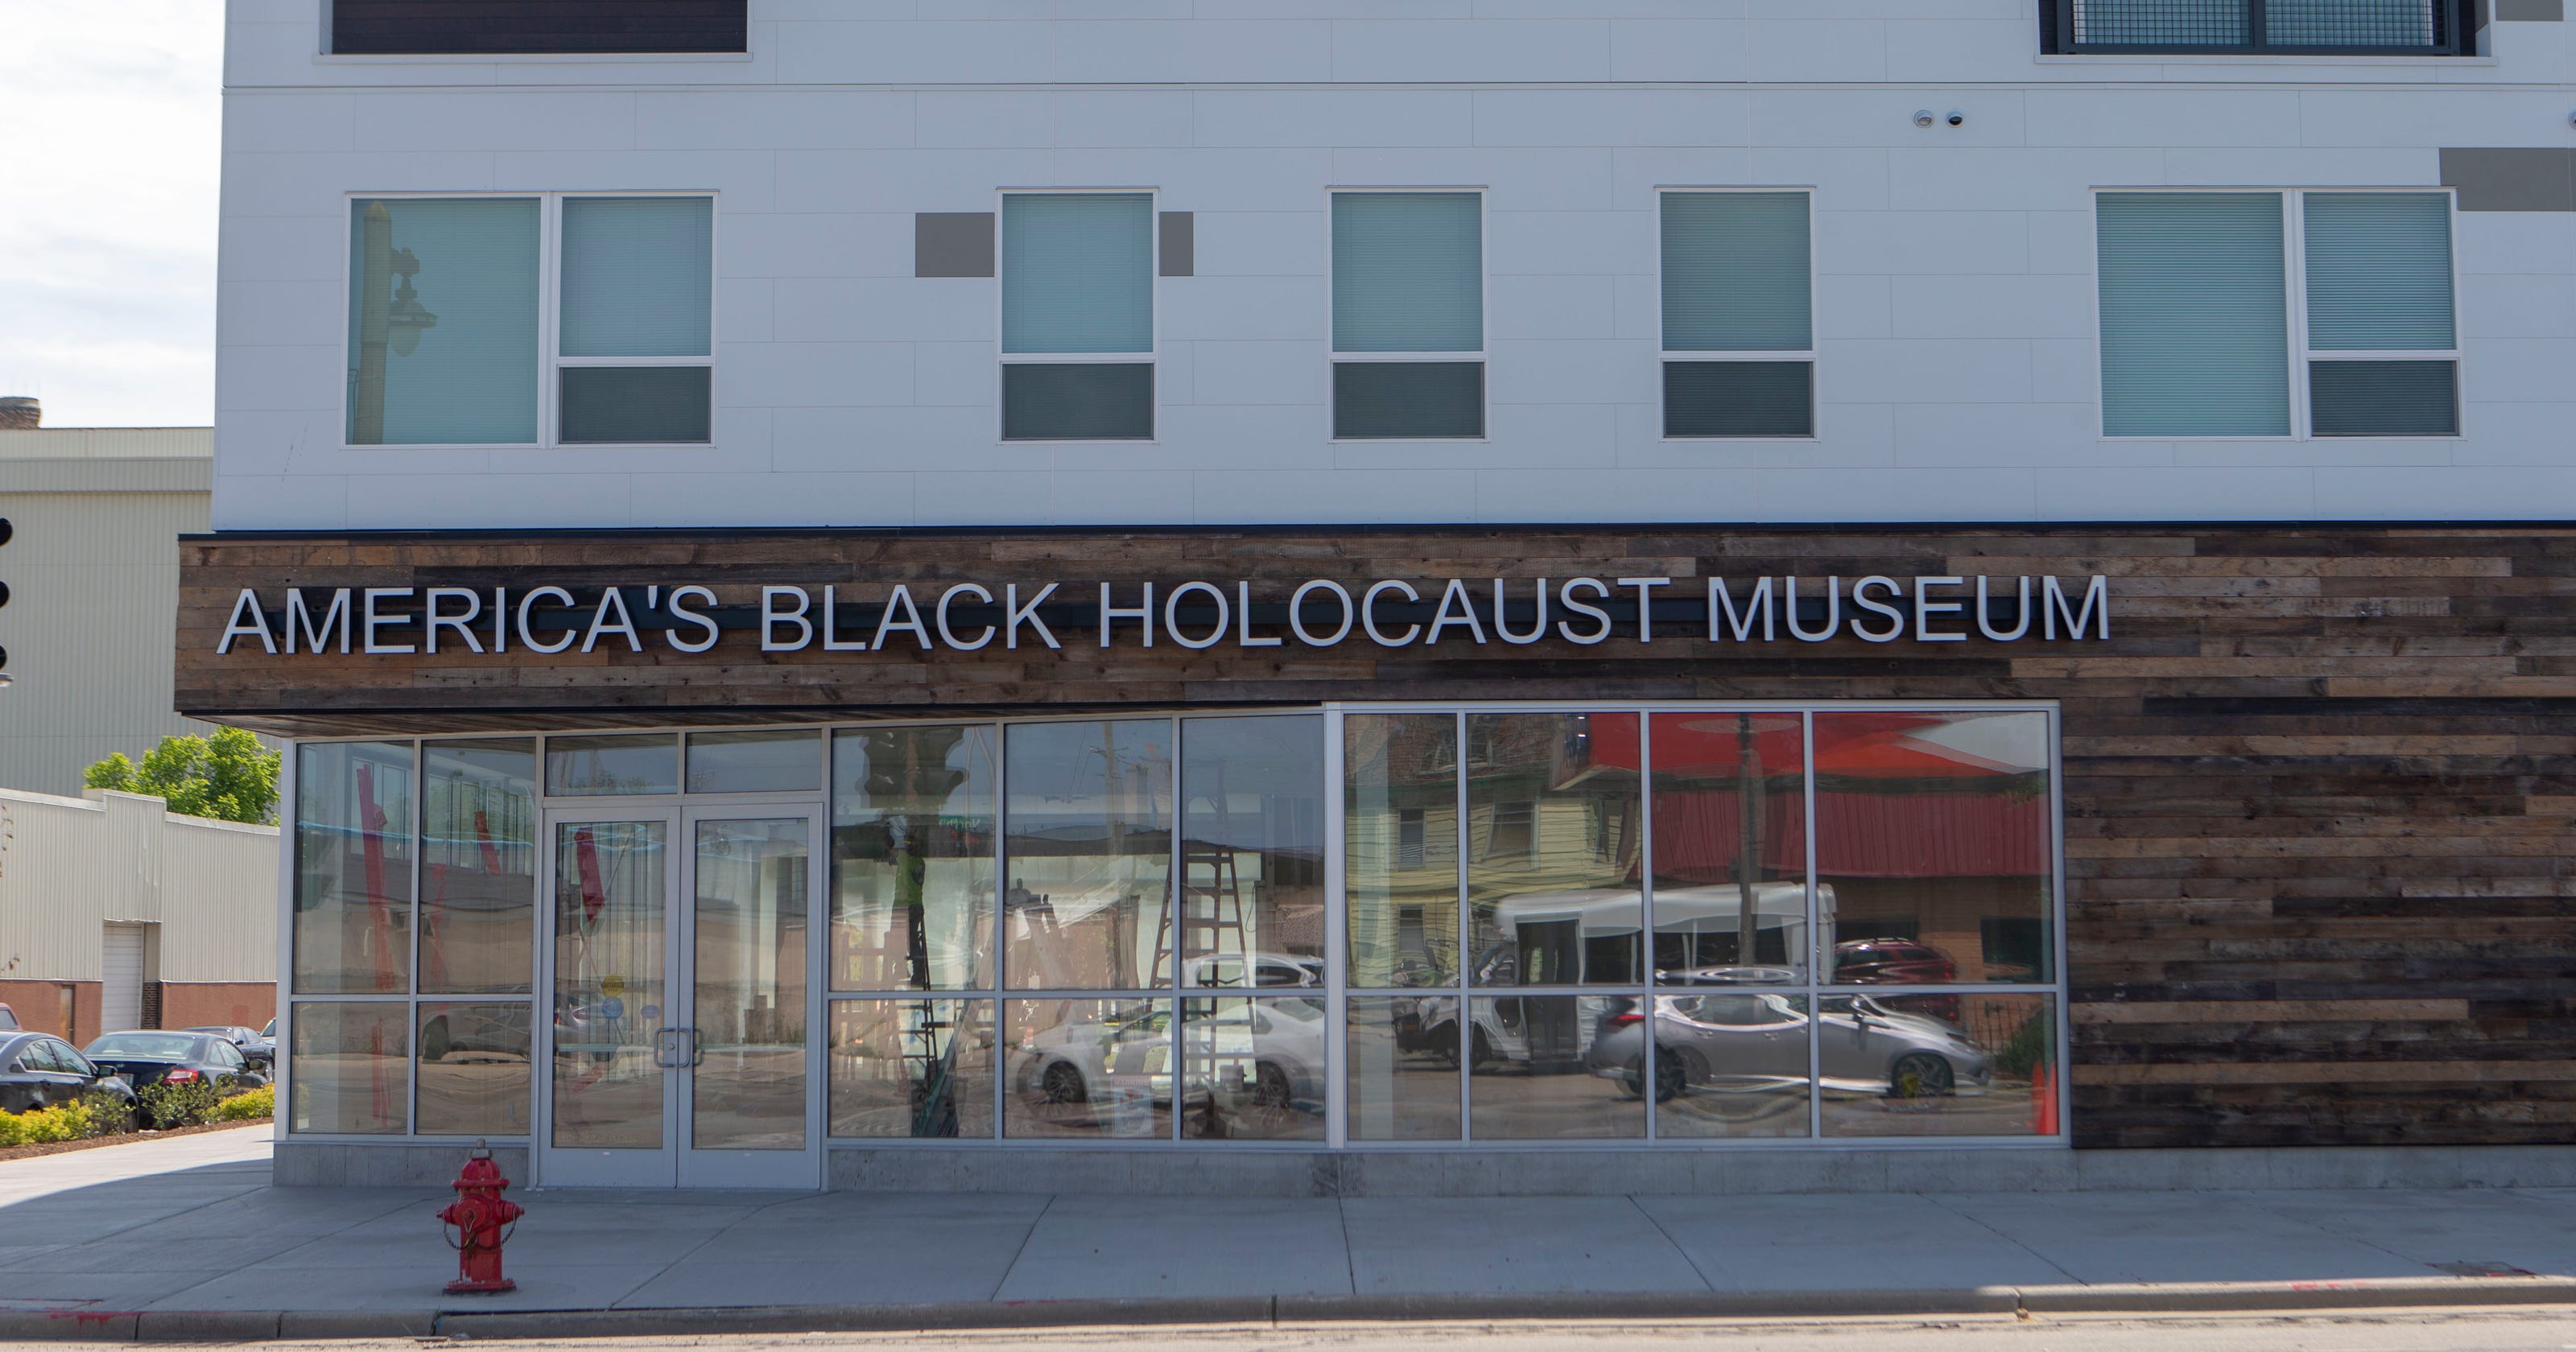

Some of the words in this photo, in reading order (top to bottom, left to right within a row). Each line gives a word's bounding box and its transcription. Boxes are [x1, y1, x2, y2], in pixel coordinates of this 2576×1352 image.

[216, 585, 719, 655] AMERICA'S
[761, 583, 1062, 652] BLACK
[1100, 576, 1670, 649] HOLOCAUST
[1707, 574, 2108, 643] MUSEUM
